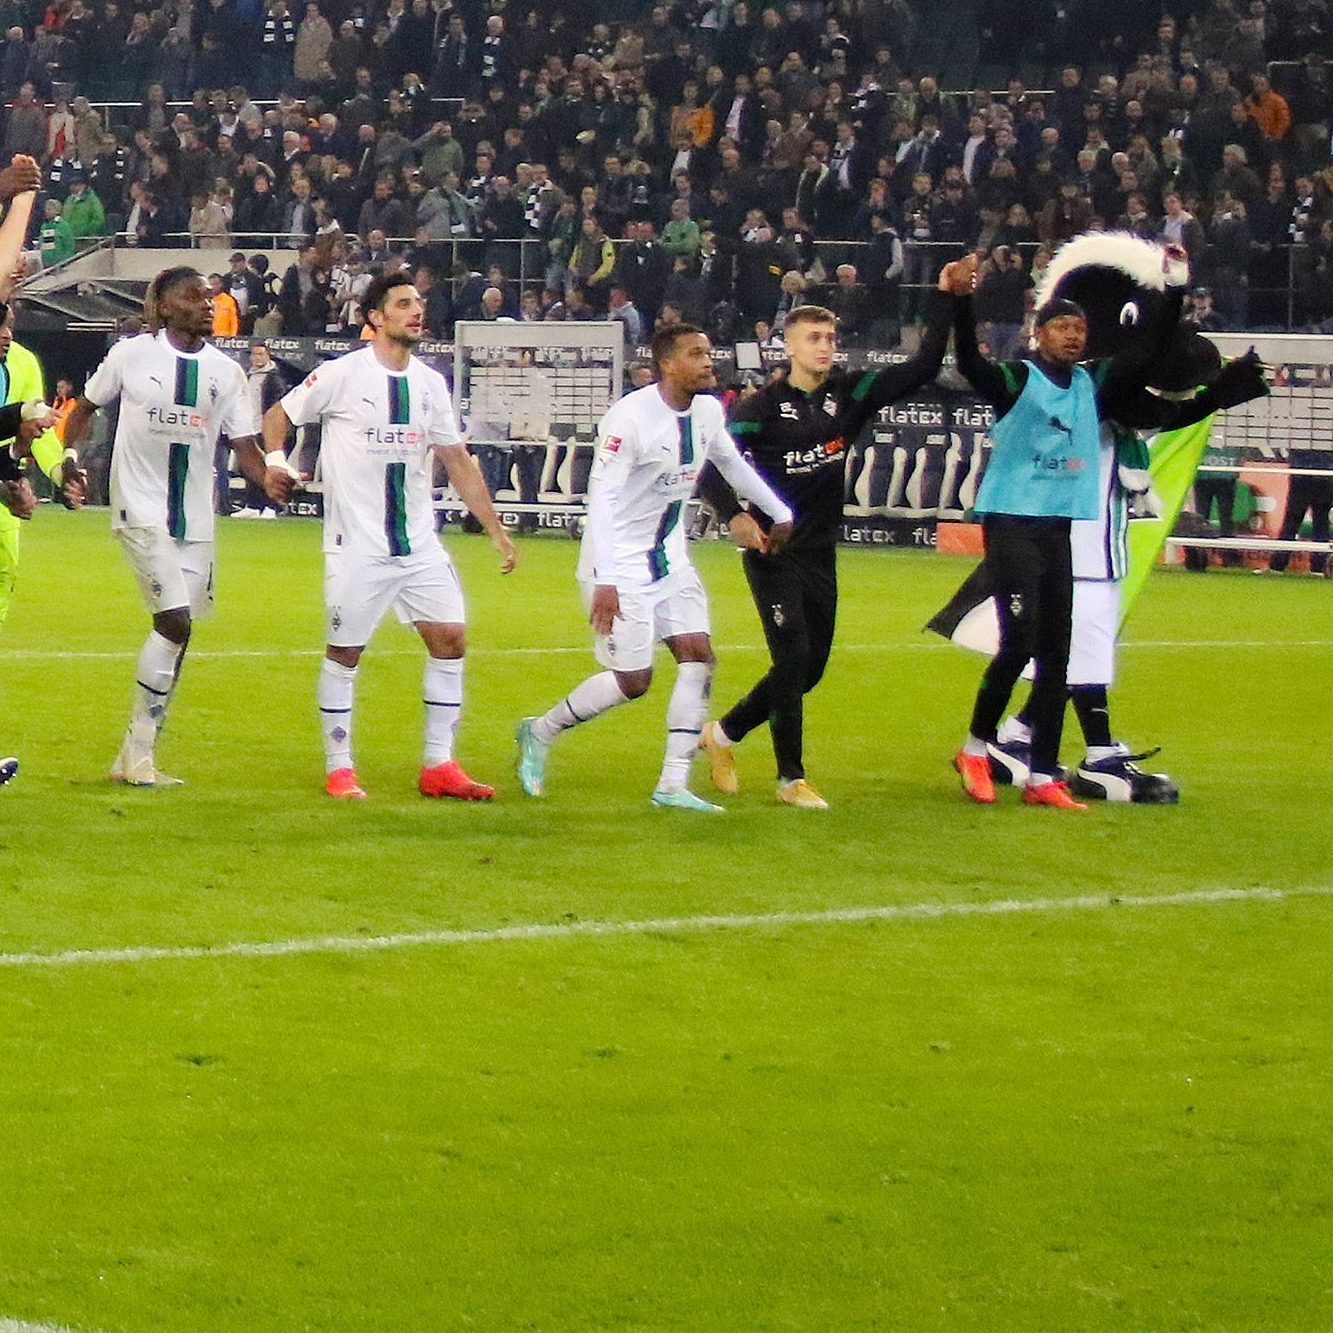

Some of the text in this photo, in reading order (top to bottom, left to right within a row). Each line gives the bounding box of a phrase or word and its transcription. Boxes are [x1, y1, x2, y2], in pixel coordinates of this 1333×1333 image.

[878, 405, 943, 426] flatex
[952, 407, 995, 427] flat
[843, 527, 896, 543] latex
